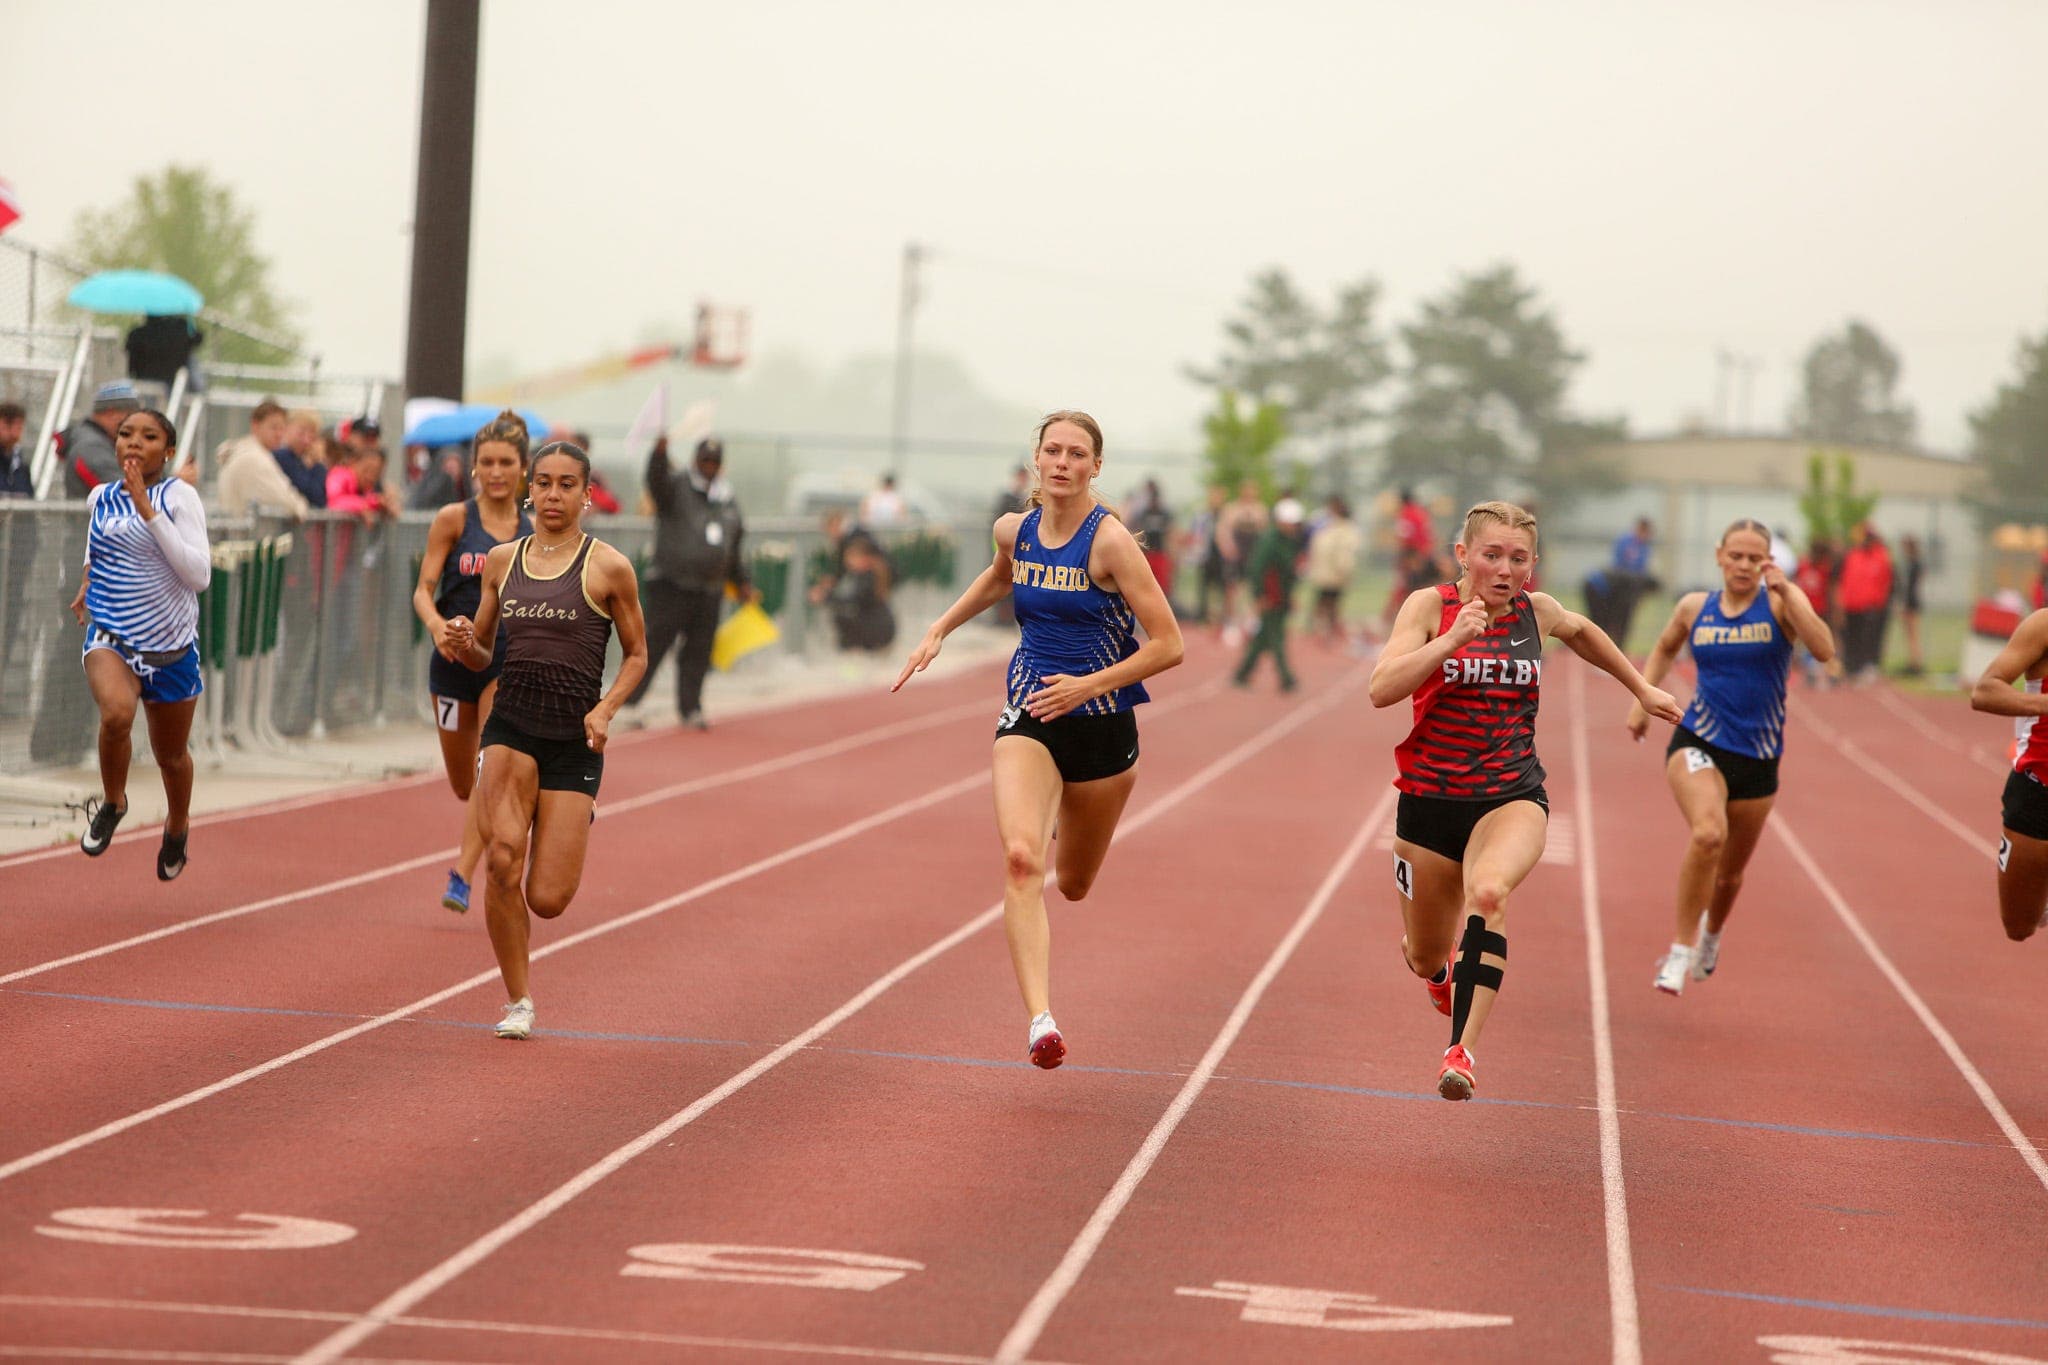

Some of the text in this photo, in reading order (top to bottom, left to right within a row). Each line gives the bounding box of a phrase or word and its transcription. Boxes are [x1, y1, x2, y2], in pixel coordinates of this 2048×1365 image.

[459, 553, 488, 576] GA
[501, 599, 578, 621] Sailors
[1693, 622, 1771, 645] ONTARIO
[1442, 658, 1541, 686] SHELBY
[440, 701, 453, 725] 7
[1395, 861, 1410, 893] 4
[1174, 1280, 1514, 1331] 4
